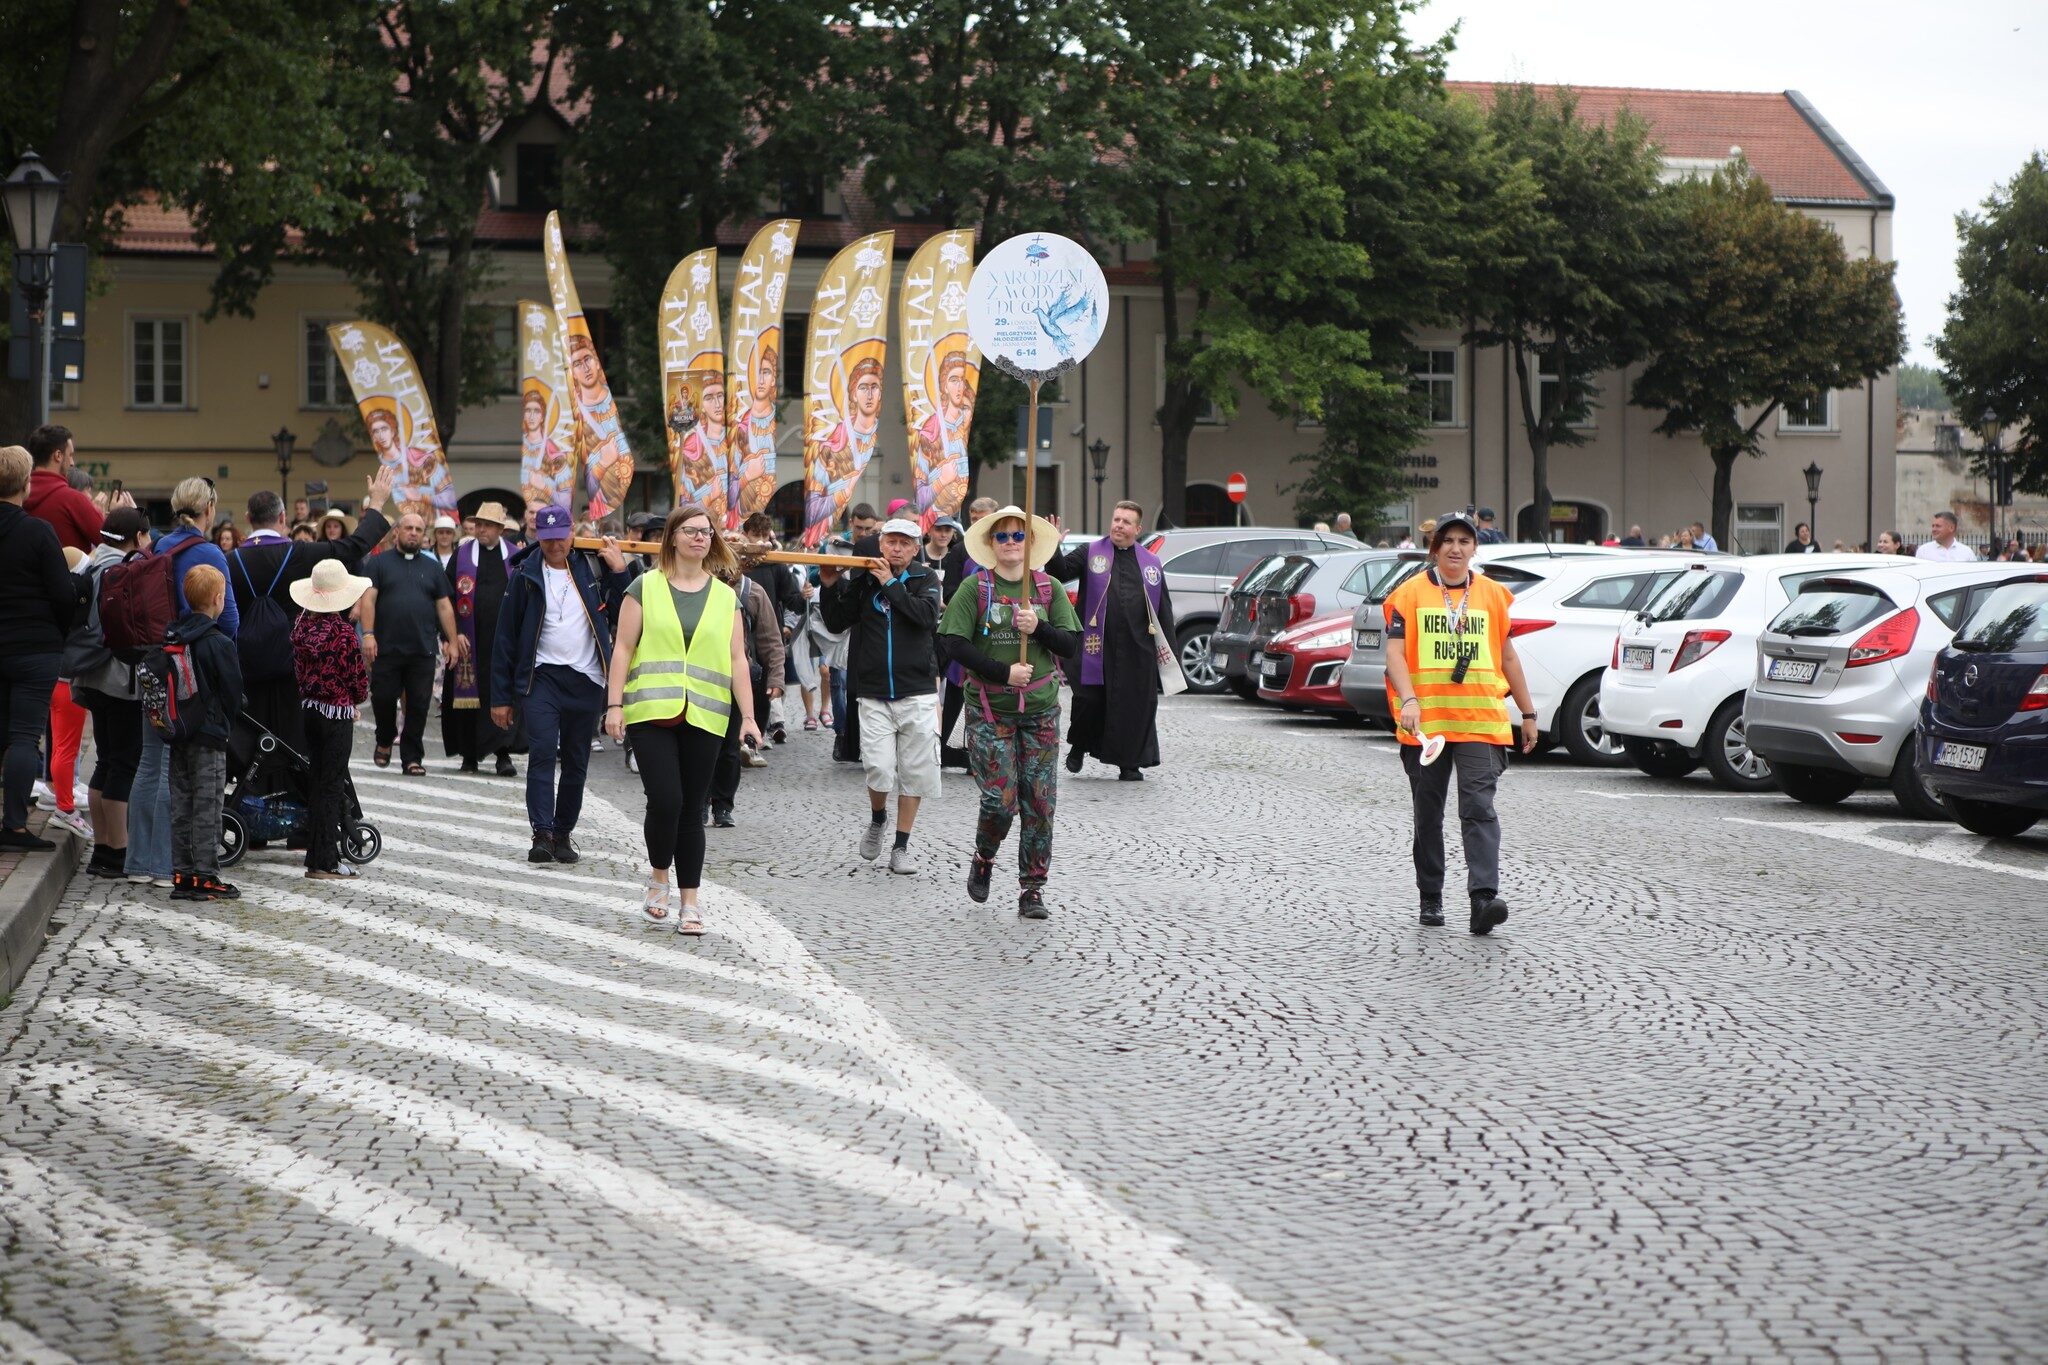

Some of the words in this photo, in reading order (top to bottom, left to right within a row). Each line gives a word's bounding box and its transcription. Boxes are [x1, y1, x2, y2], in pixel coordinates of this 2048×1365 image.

[995, 318, 1010, 326] 29.
[735, 254, 764, 422] MICHAŁ
[911, 266, 934, 430] MICHAŁ
[812, 276, 847, 441] MICHAŁ
[1434, 641, 1479, 660] RUCHEM
[1773, 662, 1790, 675] ELC
[1789, 663, 1814, 678] 55720
[1959, 747, 1986, 766] 1531H
